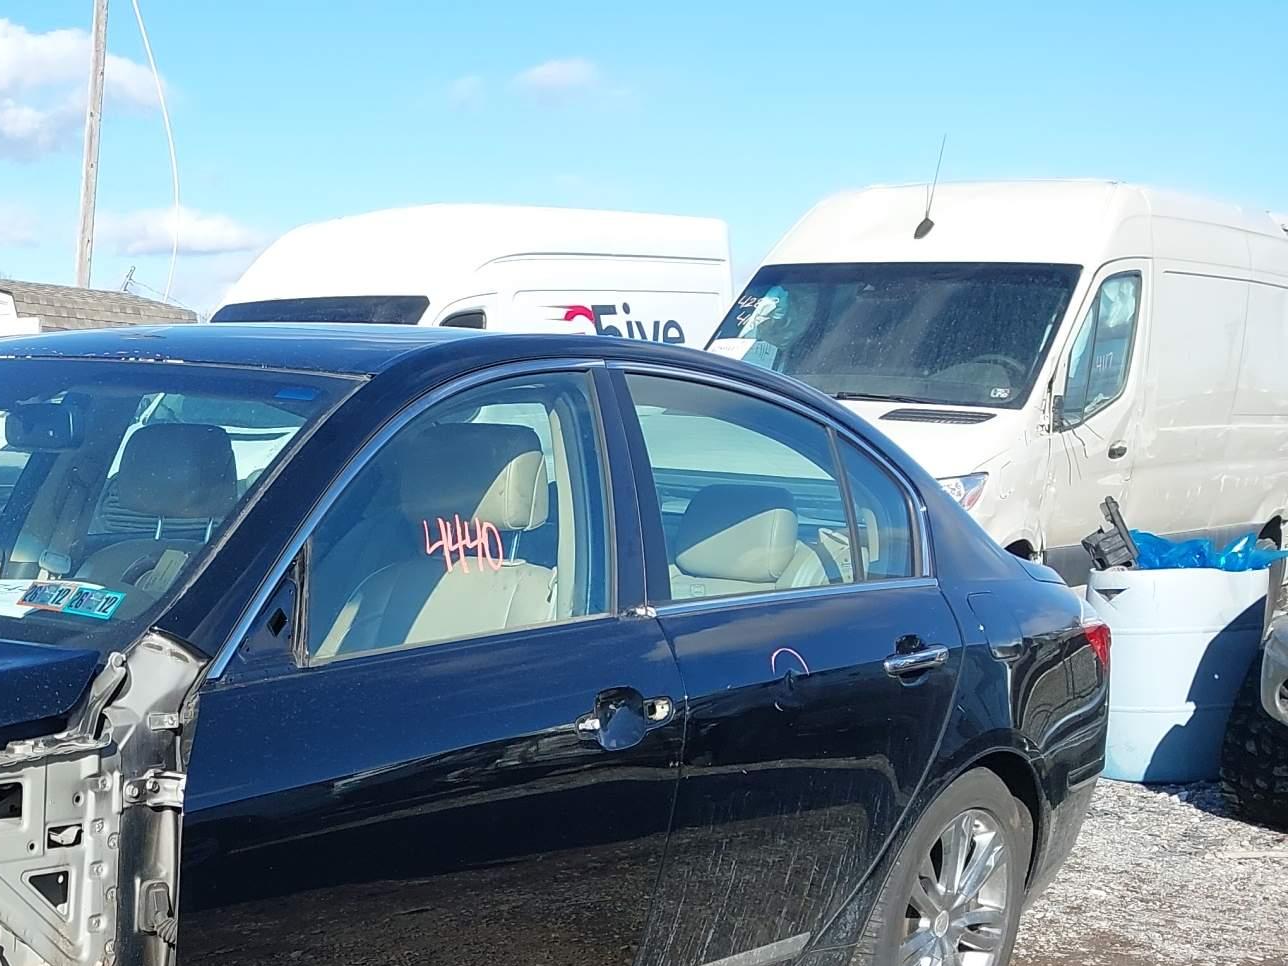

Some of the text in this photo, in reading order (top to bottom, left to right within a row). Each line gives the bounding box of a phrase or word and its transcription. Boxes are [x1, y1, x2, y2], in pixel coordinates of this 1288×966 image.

[423, 513, 504, 574] 4440
[50, 587, 71, 605] 12
[97, 596, 119, 614] 12
